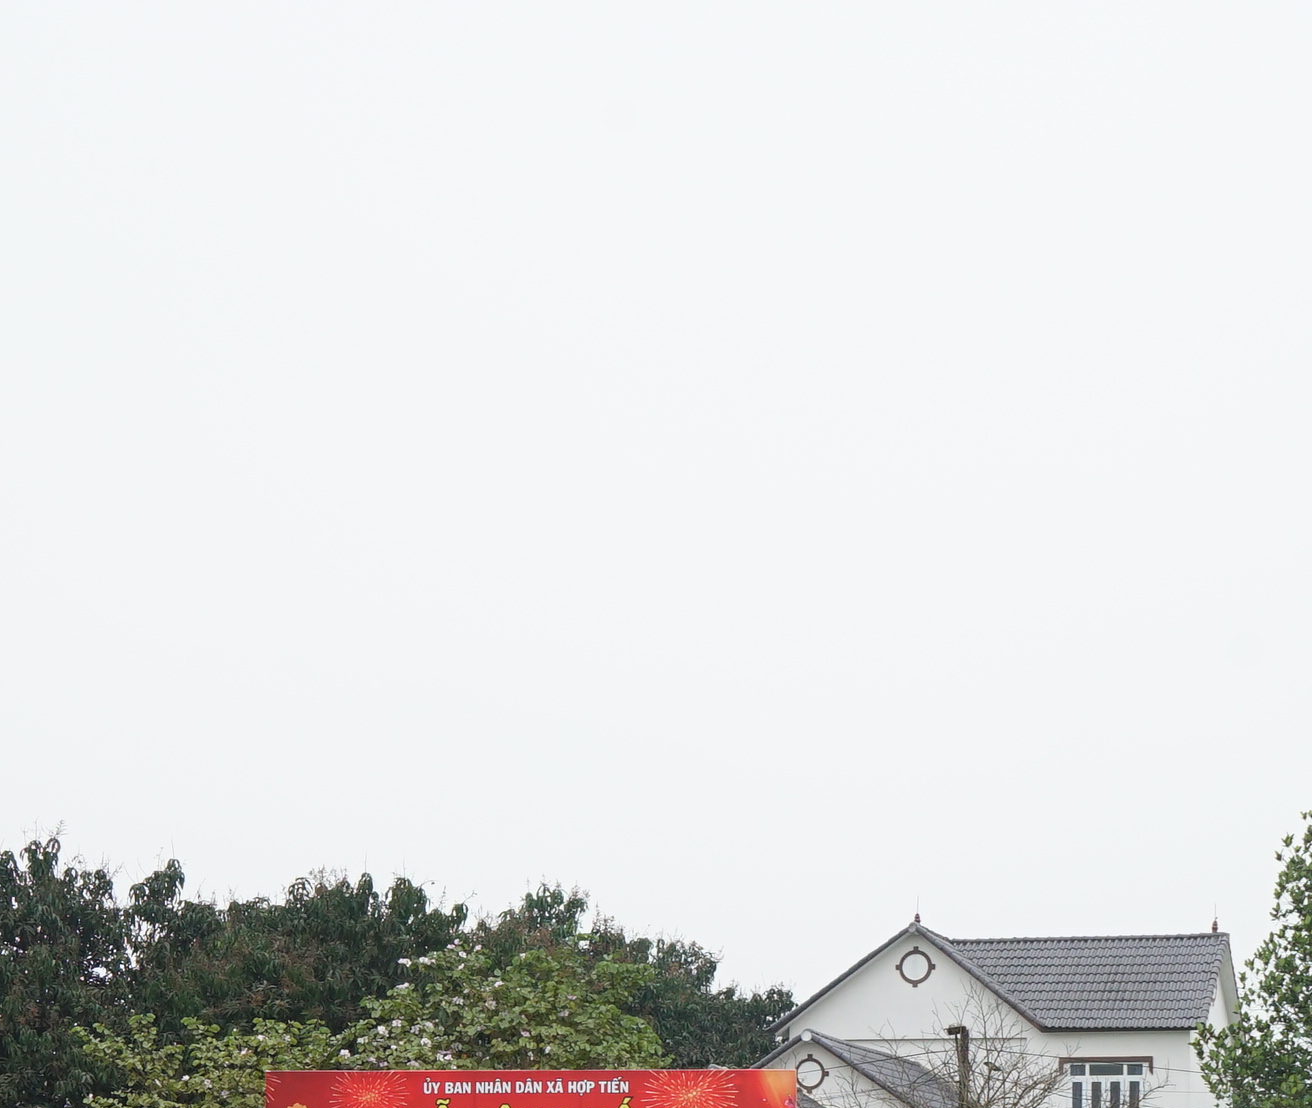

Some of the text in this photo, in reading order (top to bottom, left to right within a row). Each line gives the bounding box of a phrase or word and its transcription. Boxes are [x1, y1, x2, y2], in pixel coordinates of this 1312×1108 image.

[423, 1077, 629, 1096] ỦY BAN NHÂN DÂN XÃ HỢP TIẾN
